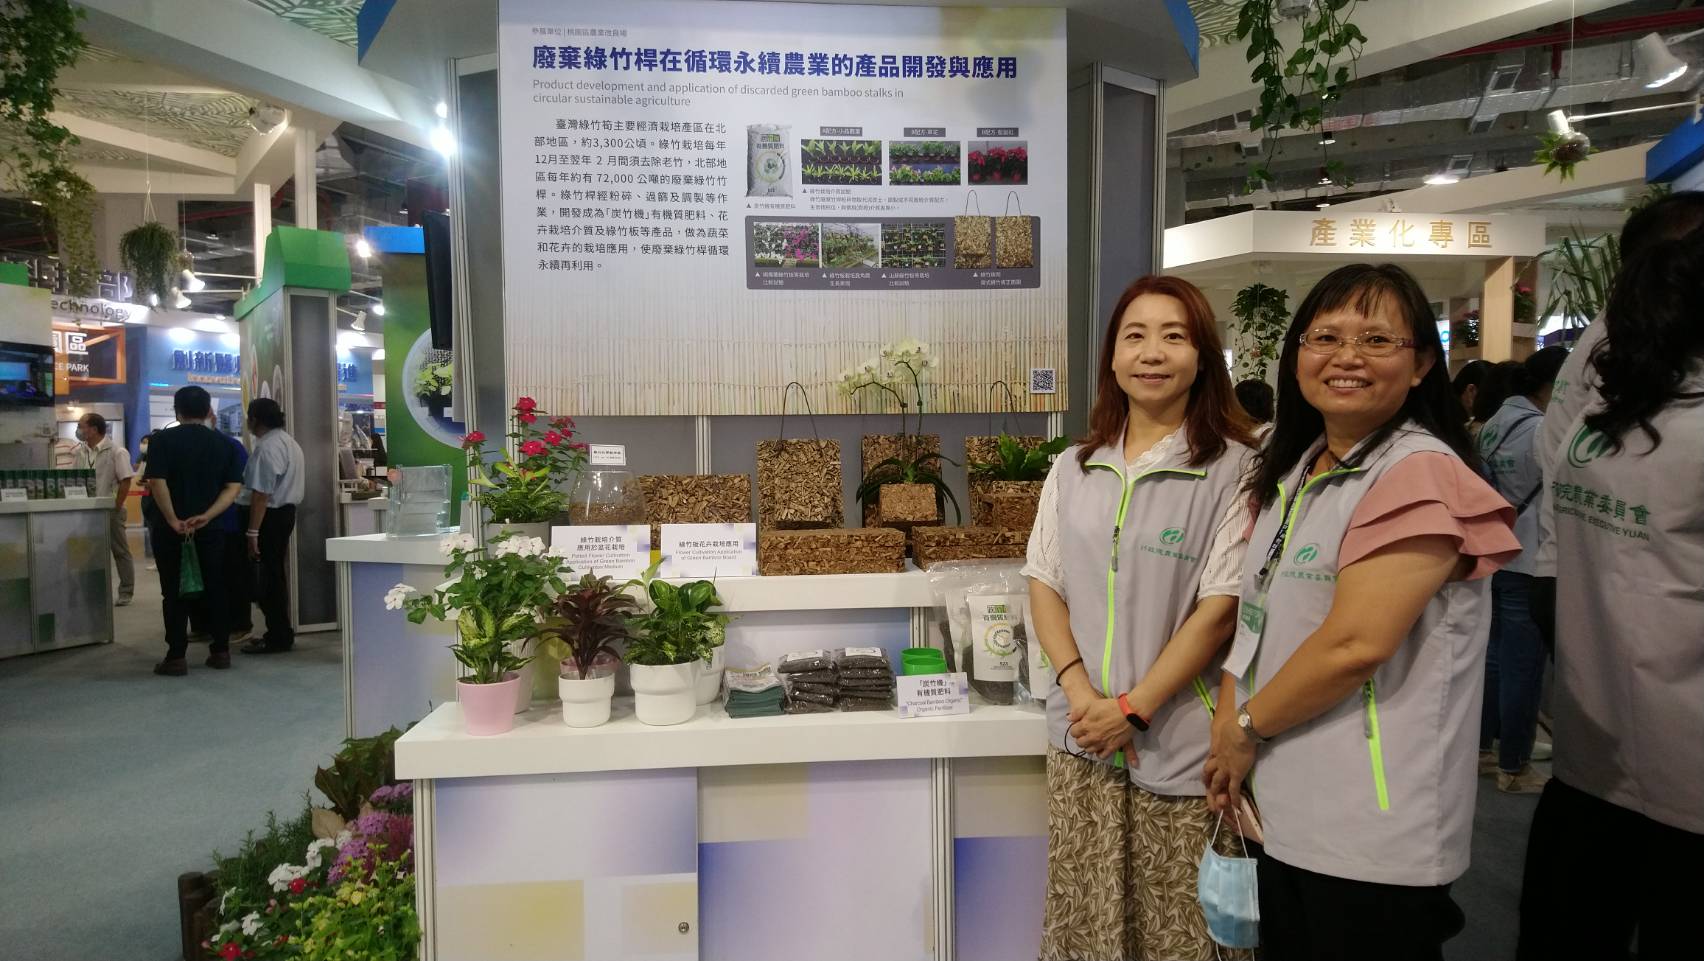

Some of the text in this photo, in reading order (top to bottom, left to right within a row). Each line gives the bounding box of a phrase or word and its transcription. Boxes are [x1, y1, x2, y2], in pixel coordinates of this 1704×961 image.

[532, 45, 1017, 79] 廢棄綠竹桿在循環永續農業的產品開發與應用
[533, 79, 904, 99] Product development and application of discarded green bamboo stalks in
[533, 93, 691, 108] circular sustainable agriculture
[1310, 217, 1493, 248] 產業化專區
[1622, 527, 1651, 541] YUAN
